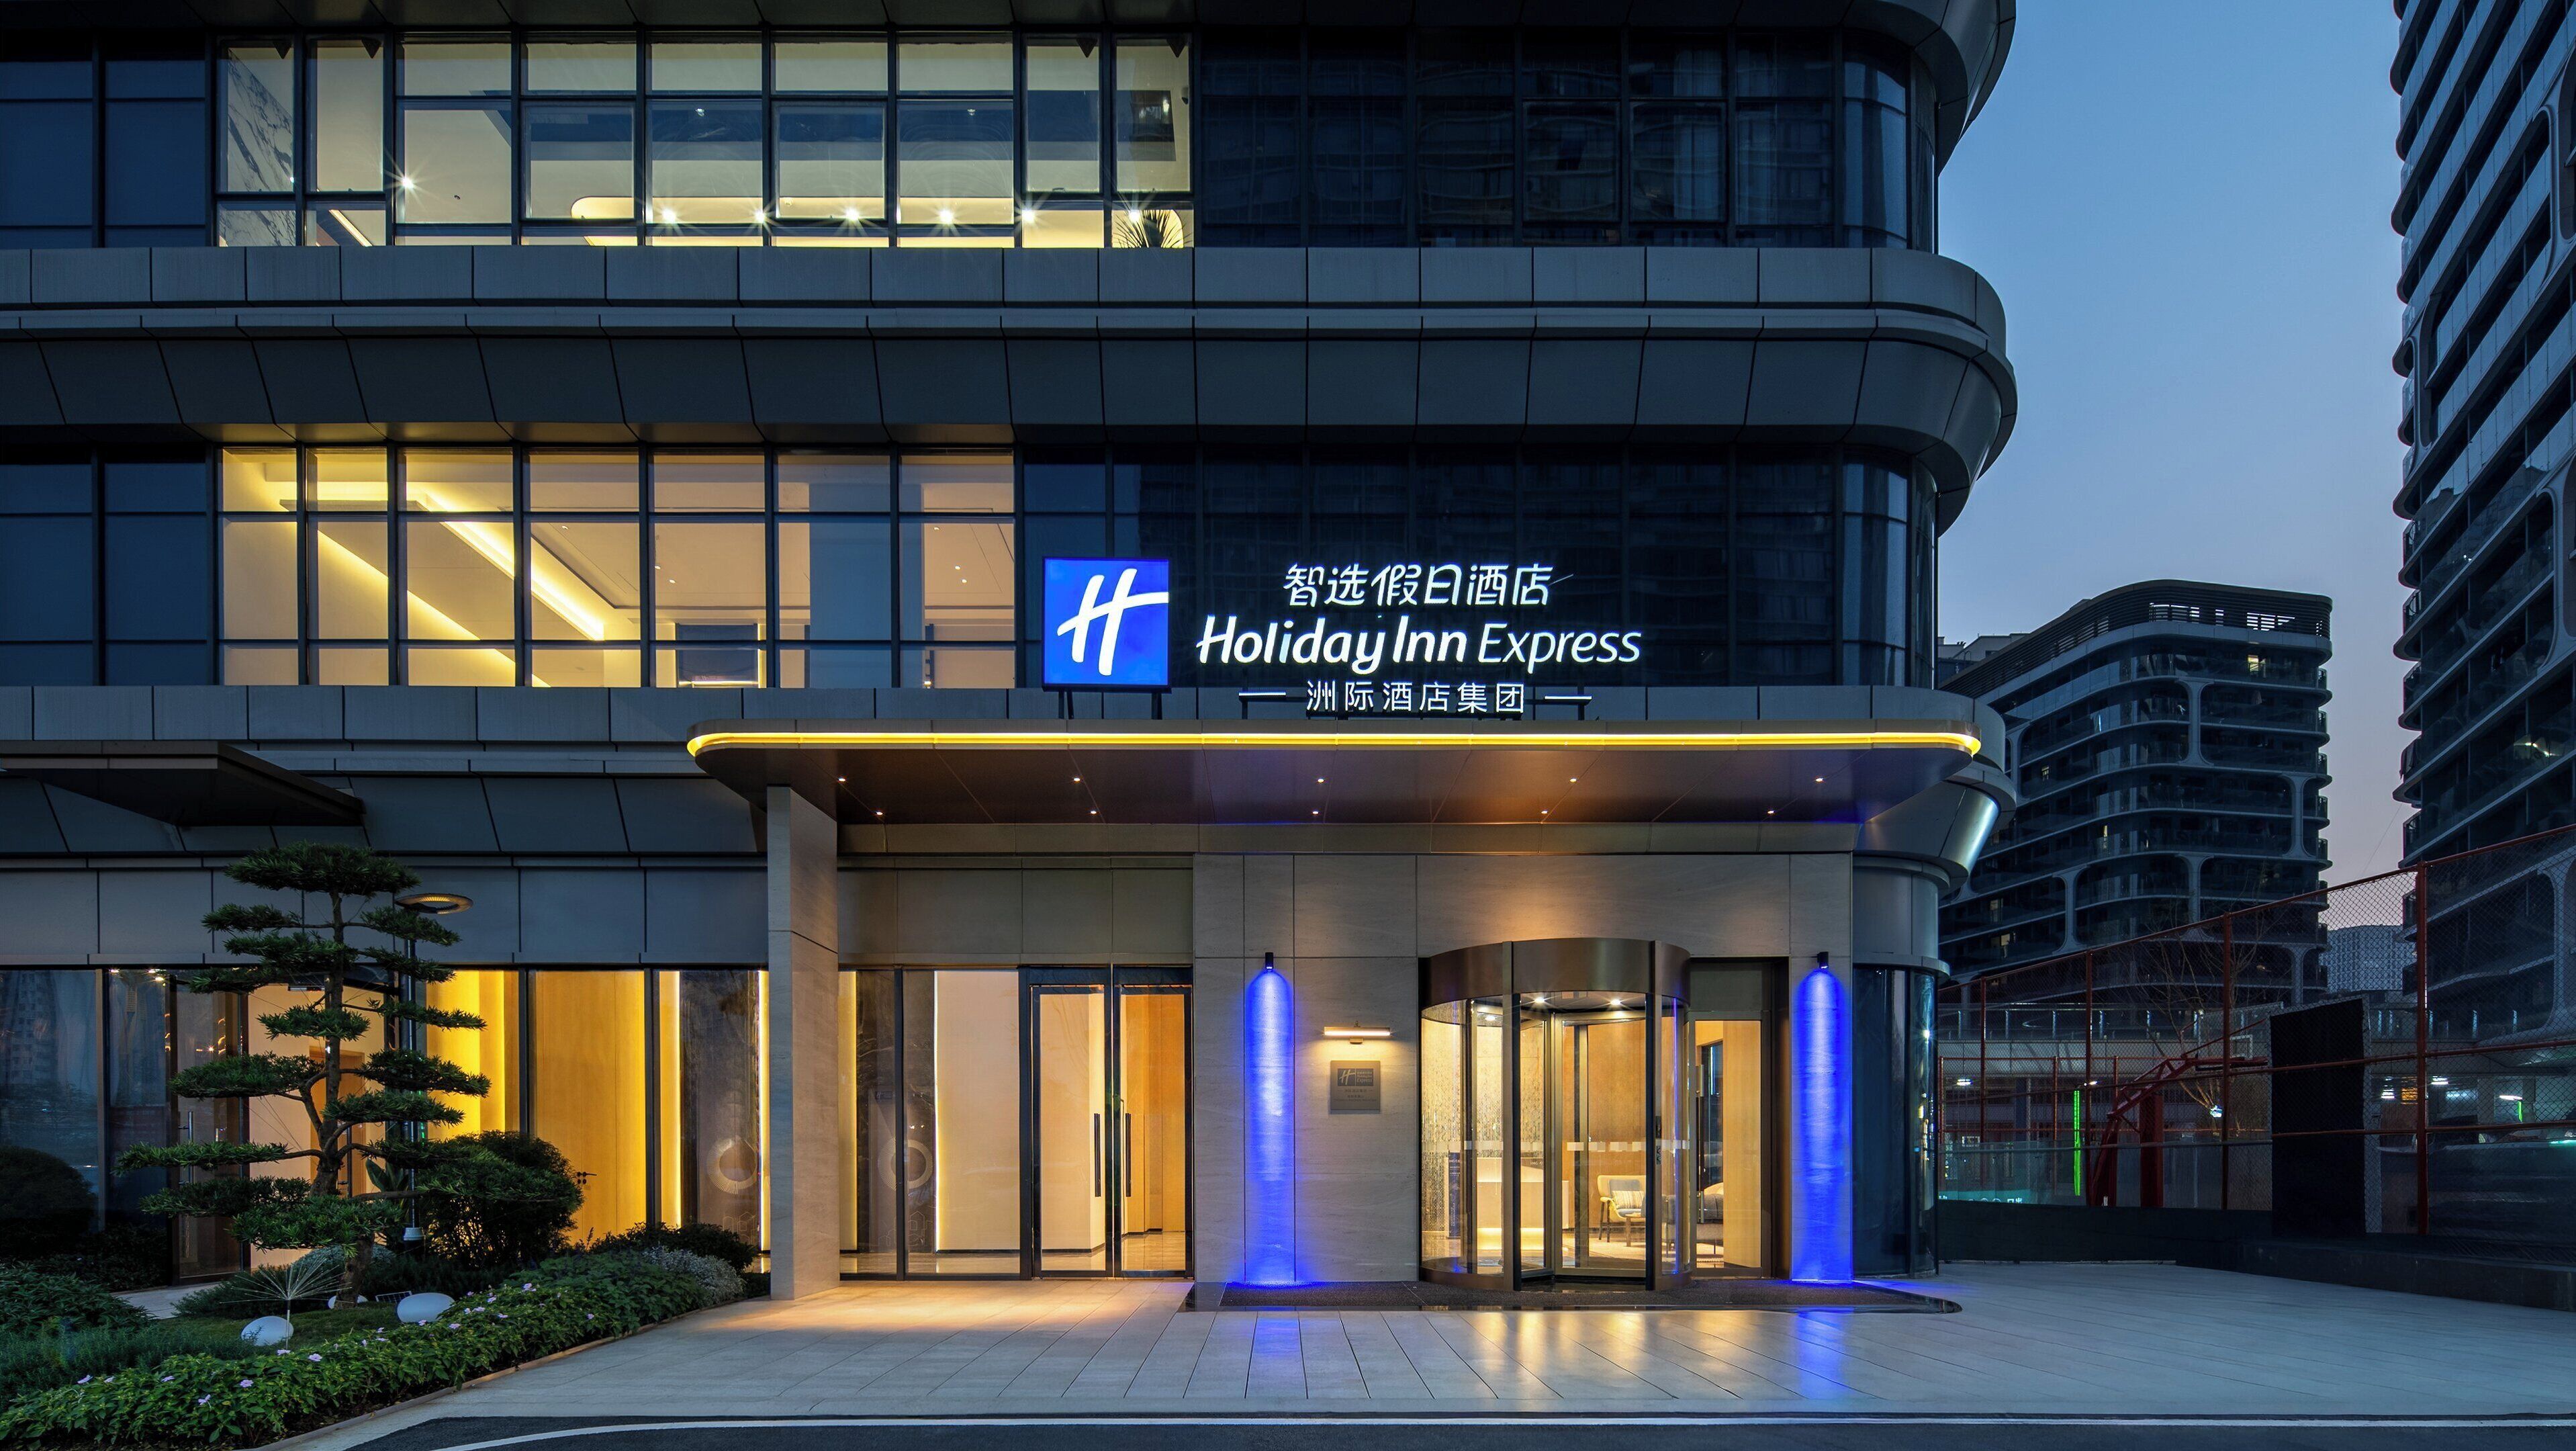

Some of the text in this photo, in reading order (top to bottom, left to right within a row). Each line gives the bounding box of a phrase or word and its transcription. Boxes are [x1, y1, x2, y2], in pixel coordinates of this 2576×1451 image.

[1283, 563, 1554, 607] 智选假日酒店
[1195, 615, 1642, 675] Holiday Inn Express
[1305, 680, 1524, 713] 洲际酒店集团
